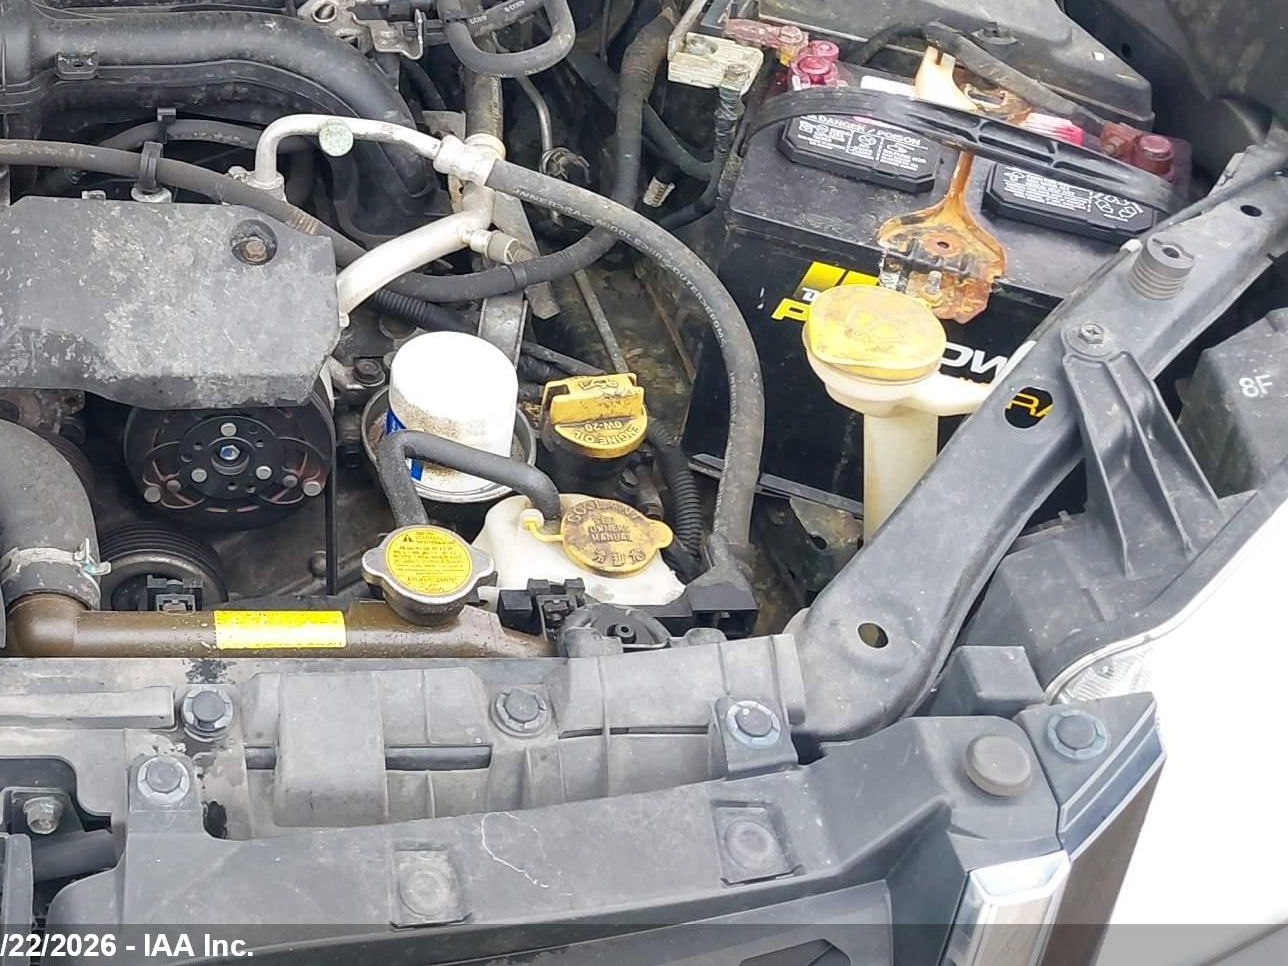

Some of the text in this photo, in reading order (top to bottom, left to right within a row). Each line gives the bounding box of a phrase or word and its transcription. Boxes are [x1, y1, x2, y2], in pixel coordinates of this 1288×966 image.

[818, 115, 866, 133] DANGER
[877, 129, 921, 146] POISON
[1239, 374, 1273, 397] 8F
[574, 425, 641, 445] ENGINE OIL
[584, 420, 623, 432] 0W-20
